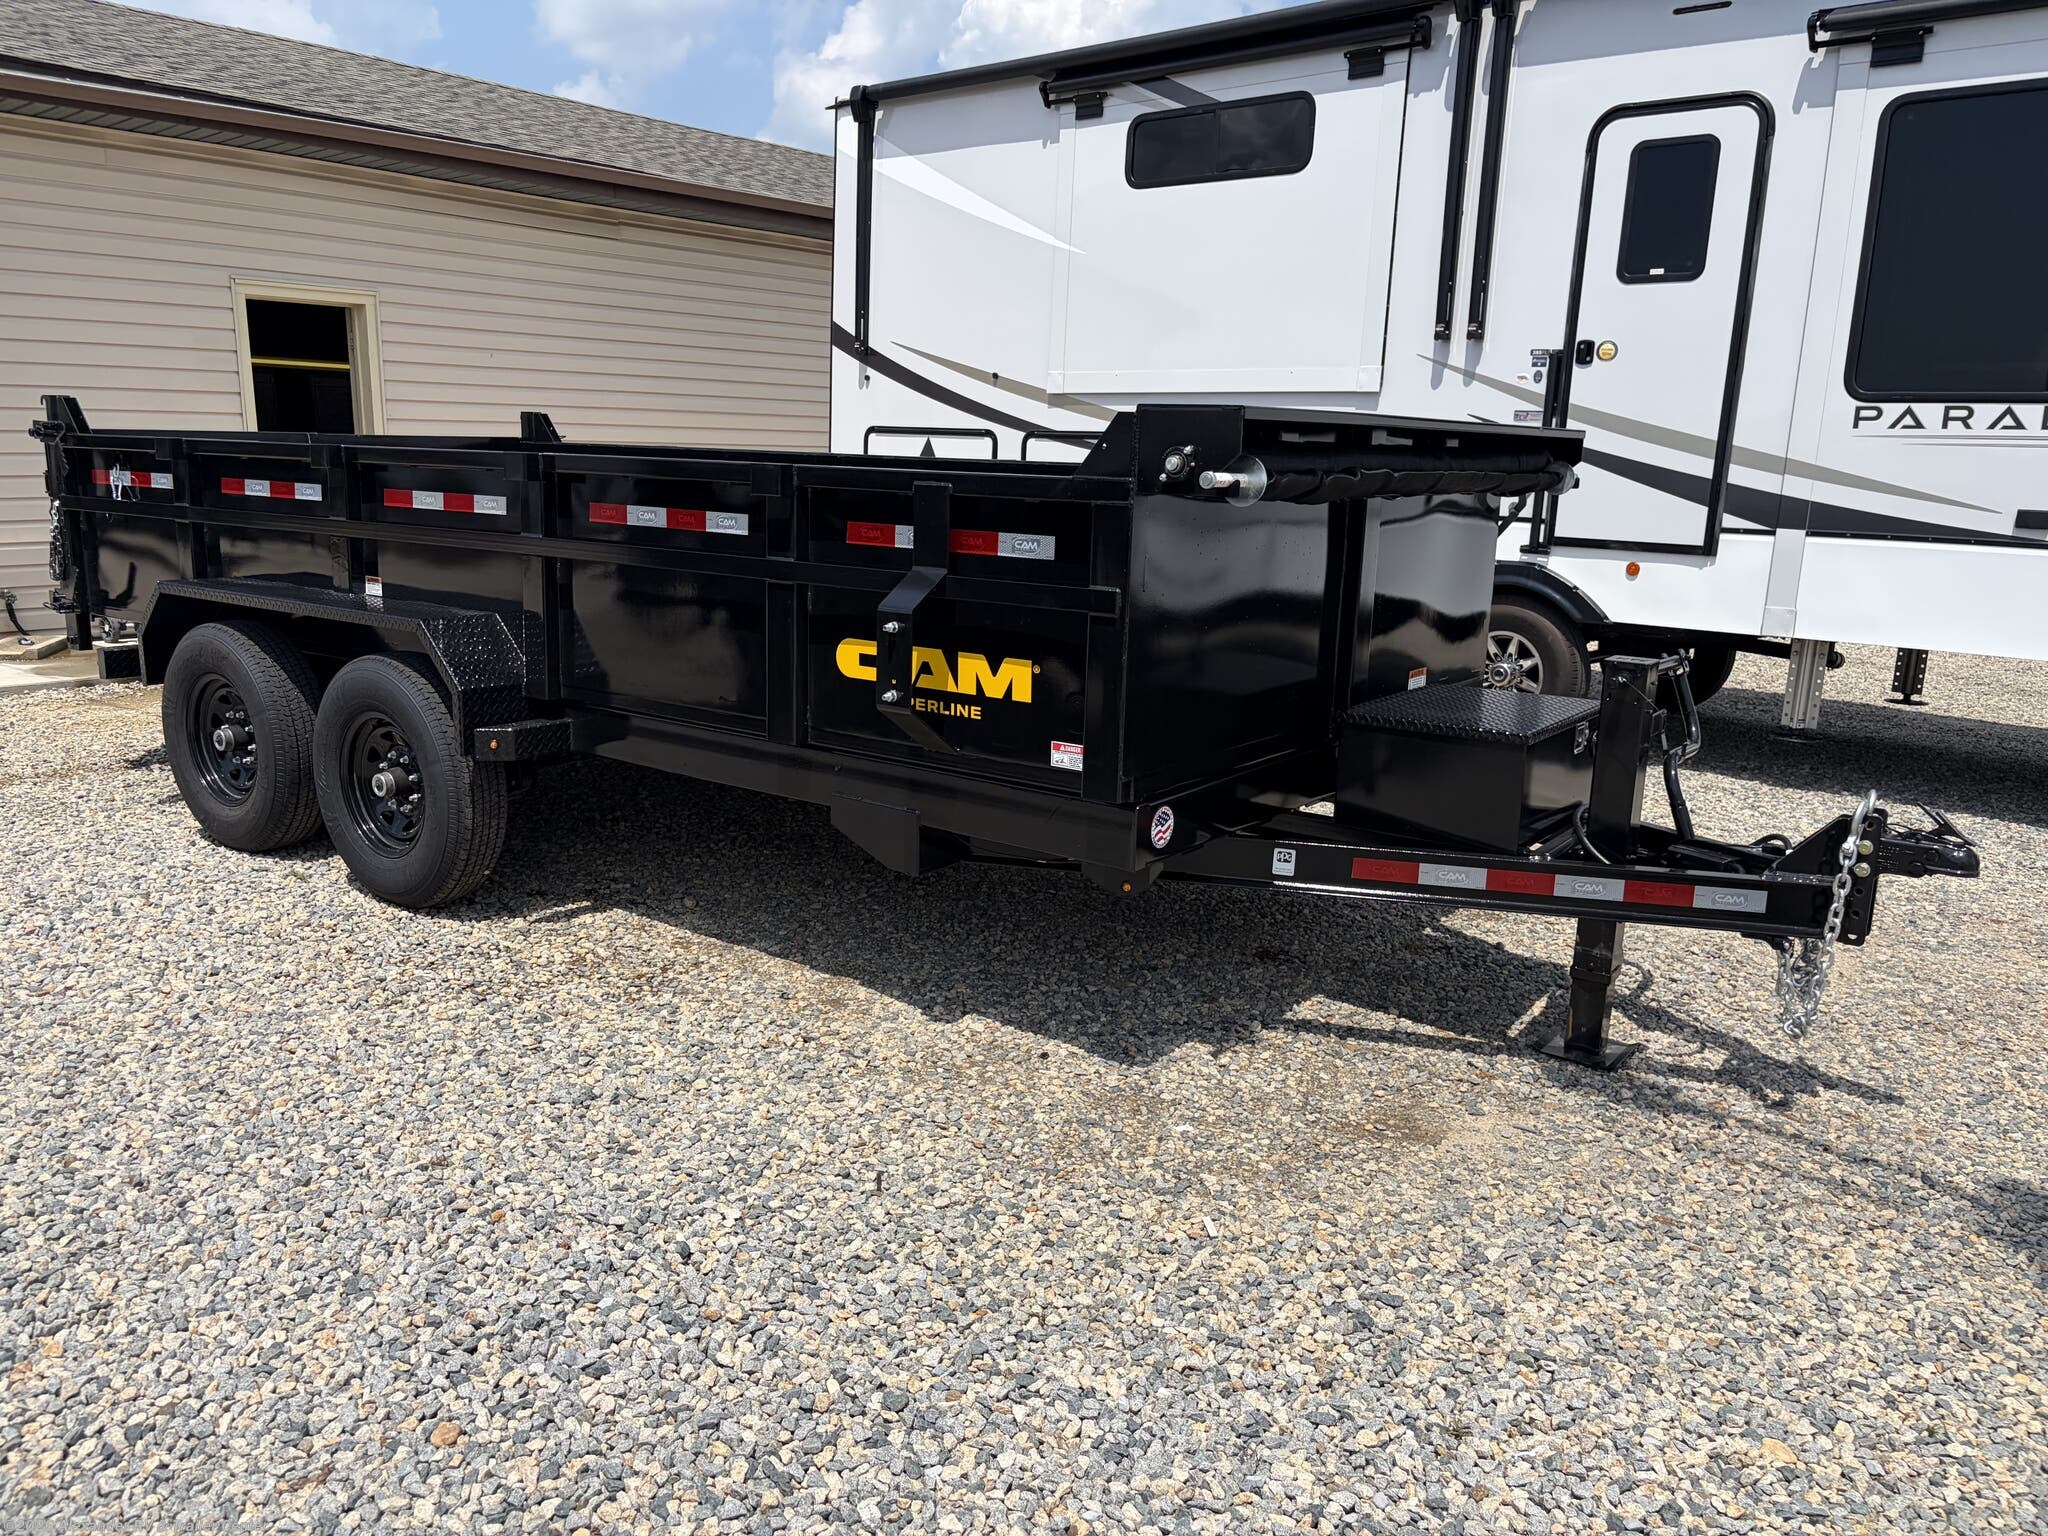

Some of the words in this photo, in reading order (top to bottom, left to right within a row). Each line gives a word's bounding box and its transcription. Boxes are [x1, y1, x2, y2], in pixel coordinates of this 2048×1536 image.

[638, 511, 656, 521] CAM
[718, 517, 736, 528] CAM
[1014, 540, 1038, 551] CAM
[1438, 870, 1466, 882] CAM
[1574, 882, 1603, 893] CAM
[1714, 893, 1745, 904] CAM
